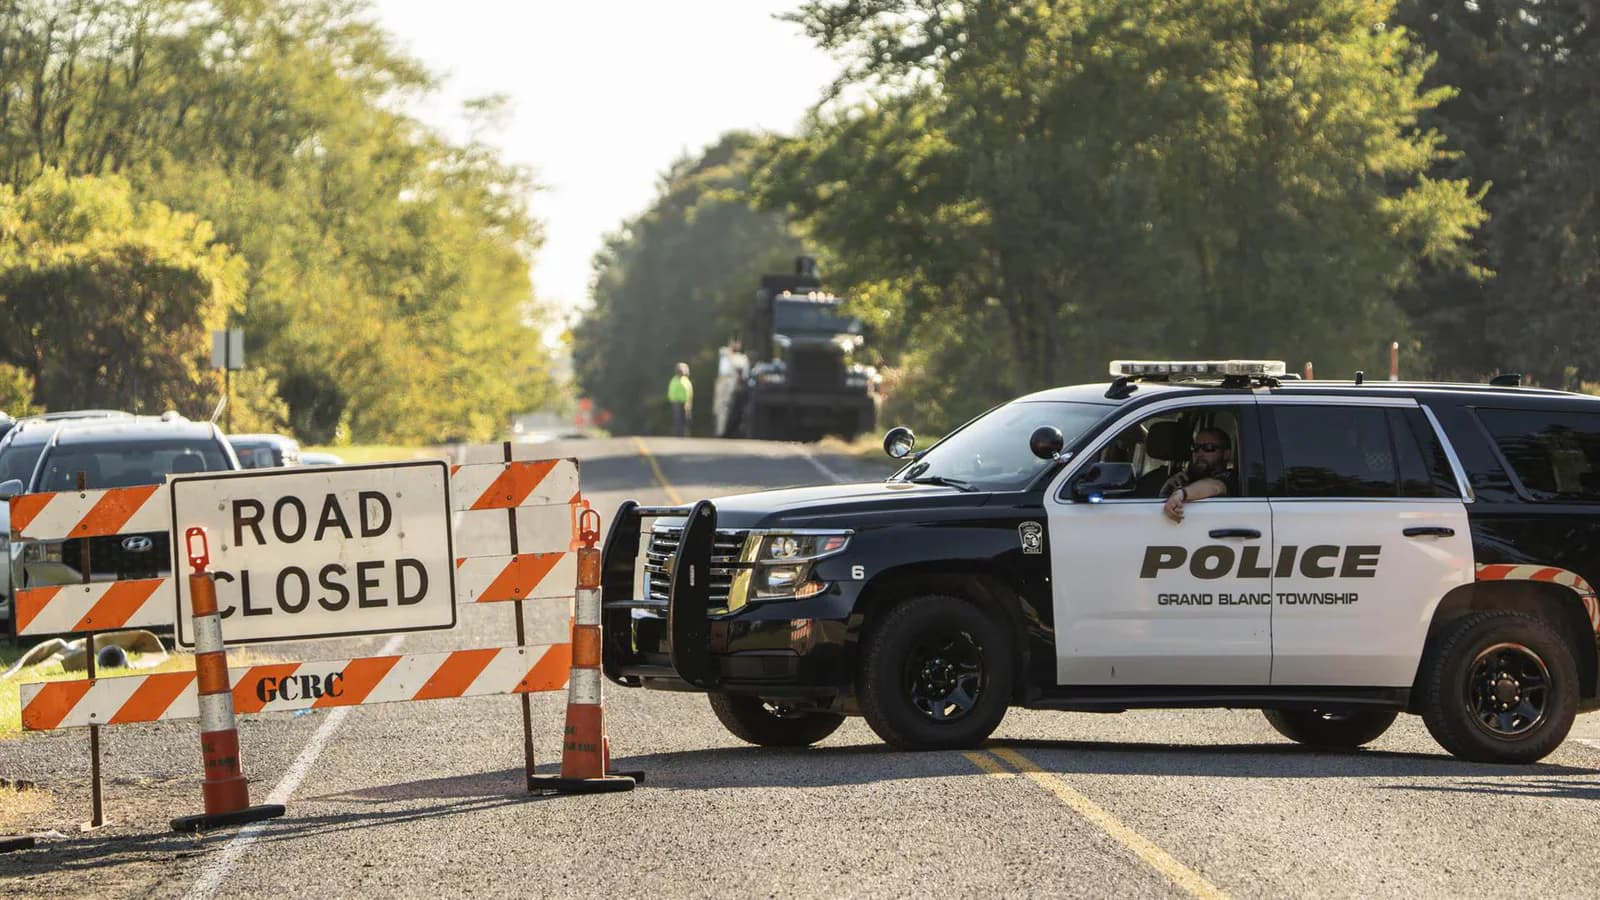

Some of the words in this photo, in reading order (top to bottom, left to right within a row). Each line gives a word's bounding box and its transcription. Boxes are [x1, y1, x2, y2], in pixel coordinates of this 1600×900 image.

[231, 490, 392, 547] ROAD
[851, 565, 865, 580] 6
[1139, 544, 1382, 580] POLICE
[1157, 593, 1213, 606] GRAND
[1218, 593, 1272, 606] BLANC
[1276, 592, 1359, 605] TOWNSHIP
[256, 672, 344, 703] GCRC
